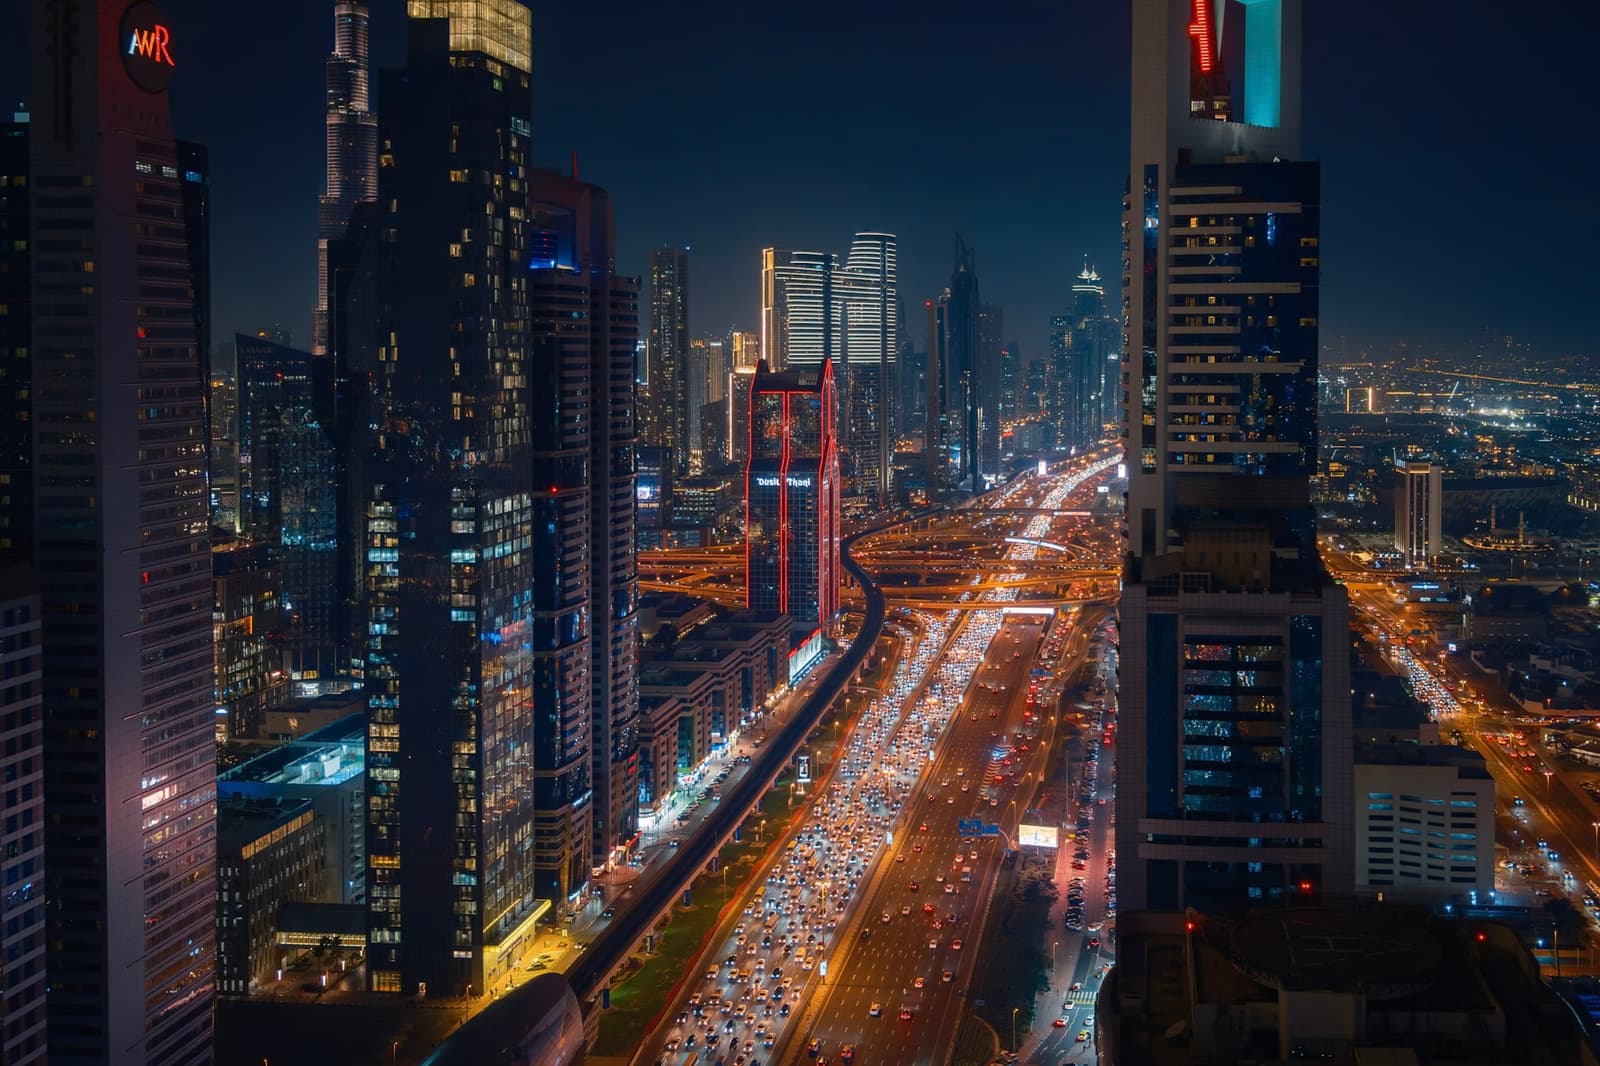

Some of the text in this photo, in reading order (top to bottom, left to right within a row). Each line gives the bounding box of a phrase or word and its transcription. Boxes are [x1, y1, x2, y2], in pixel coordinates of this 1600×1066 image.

[128, 24, 175, 66] AWR
[756, 477, 811, 488] Dusit Thani
